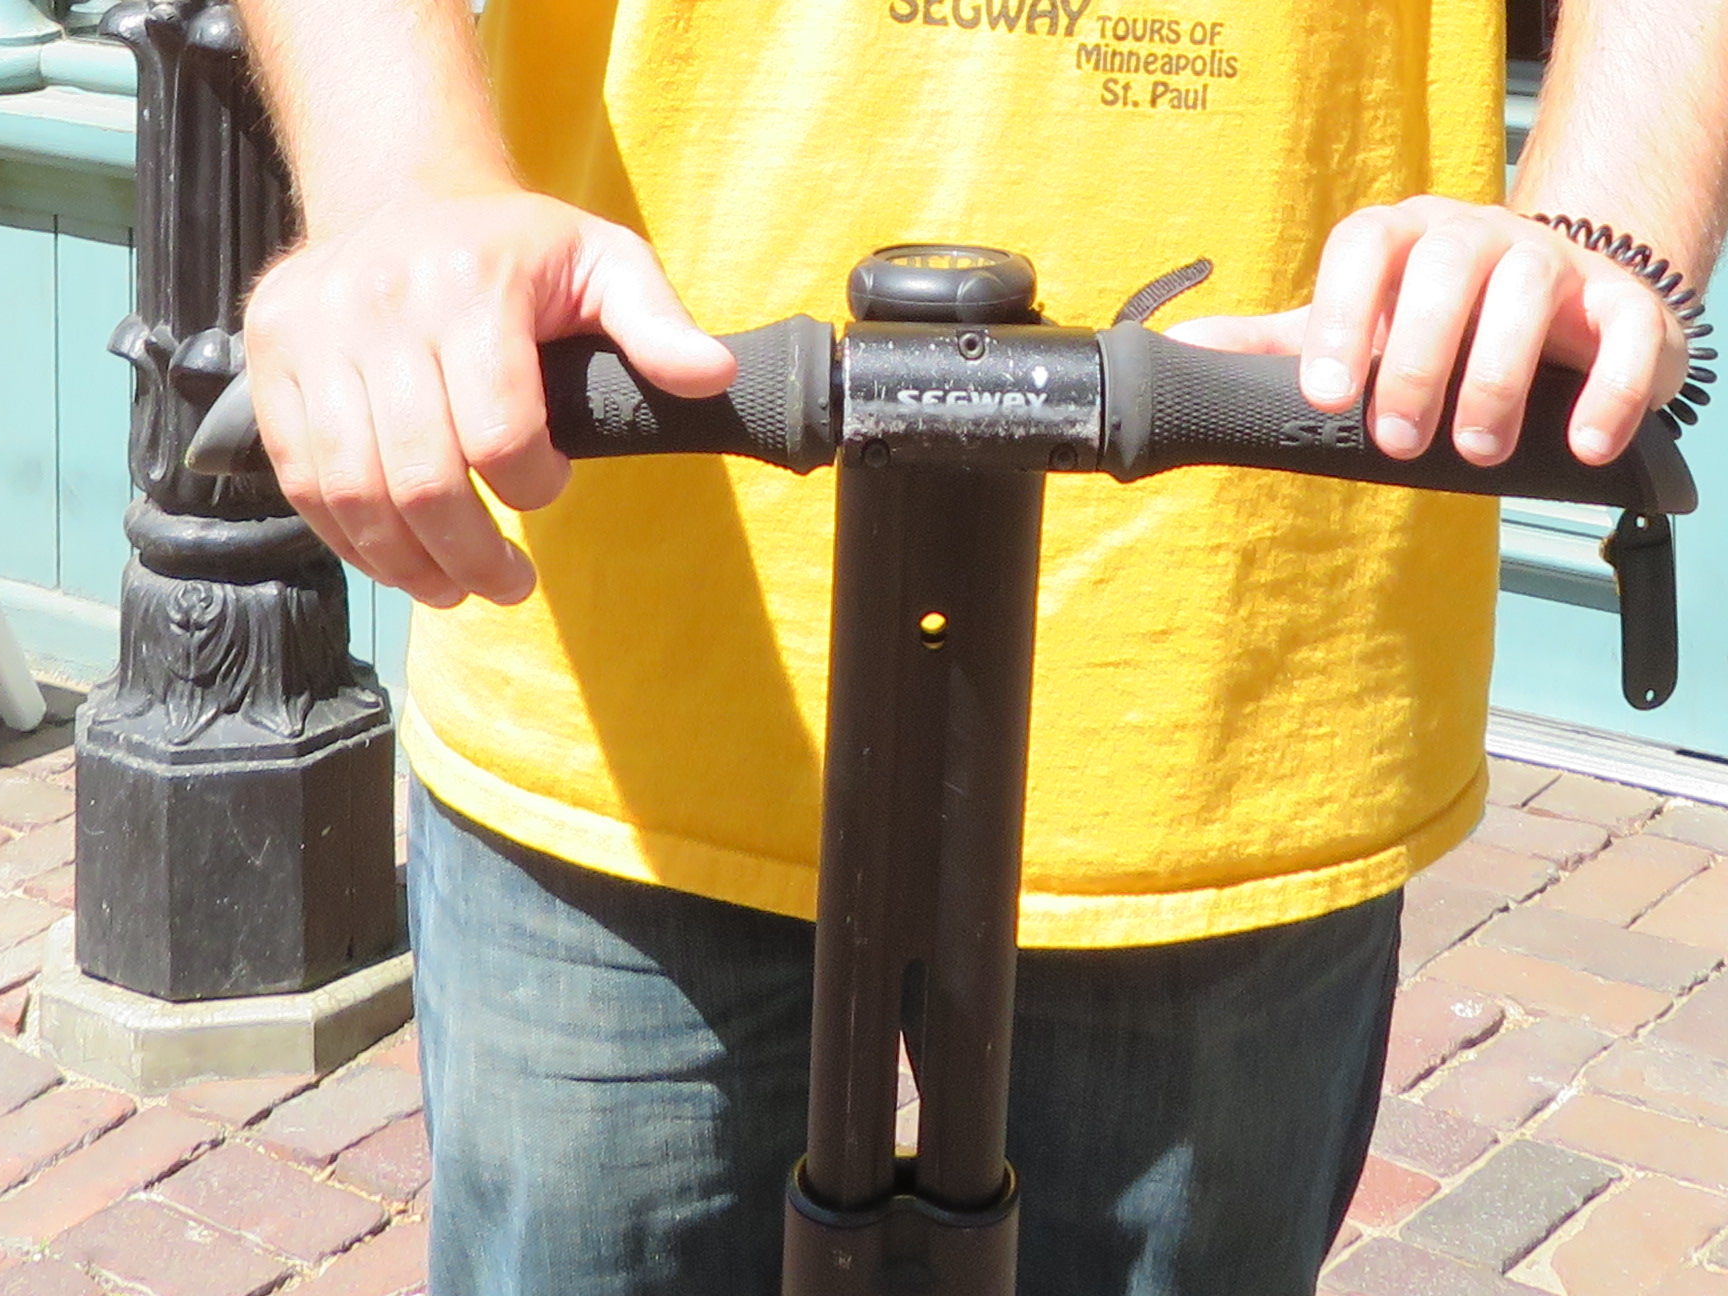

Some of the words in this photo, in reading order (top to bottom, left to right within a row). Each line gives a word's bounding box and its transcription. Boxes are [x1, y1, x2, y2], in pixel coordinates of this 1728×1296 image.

[1096, 15, 1182, 44] TOURS
[1189, 21, 1225, 46] OF
[1076, 42, 1238, 79] Minneapolis
[1100, 77, 1140, 108] St.
[1149, 80, 1209, 111] Paul
